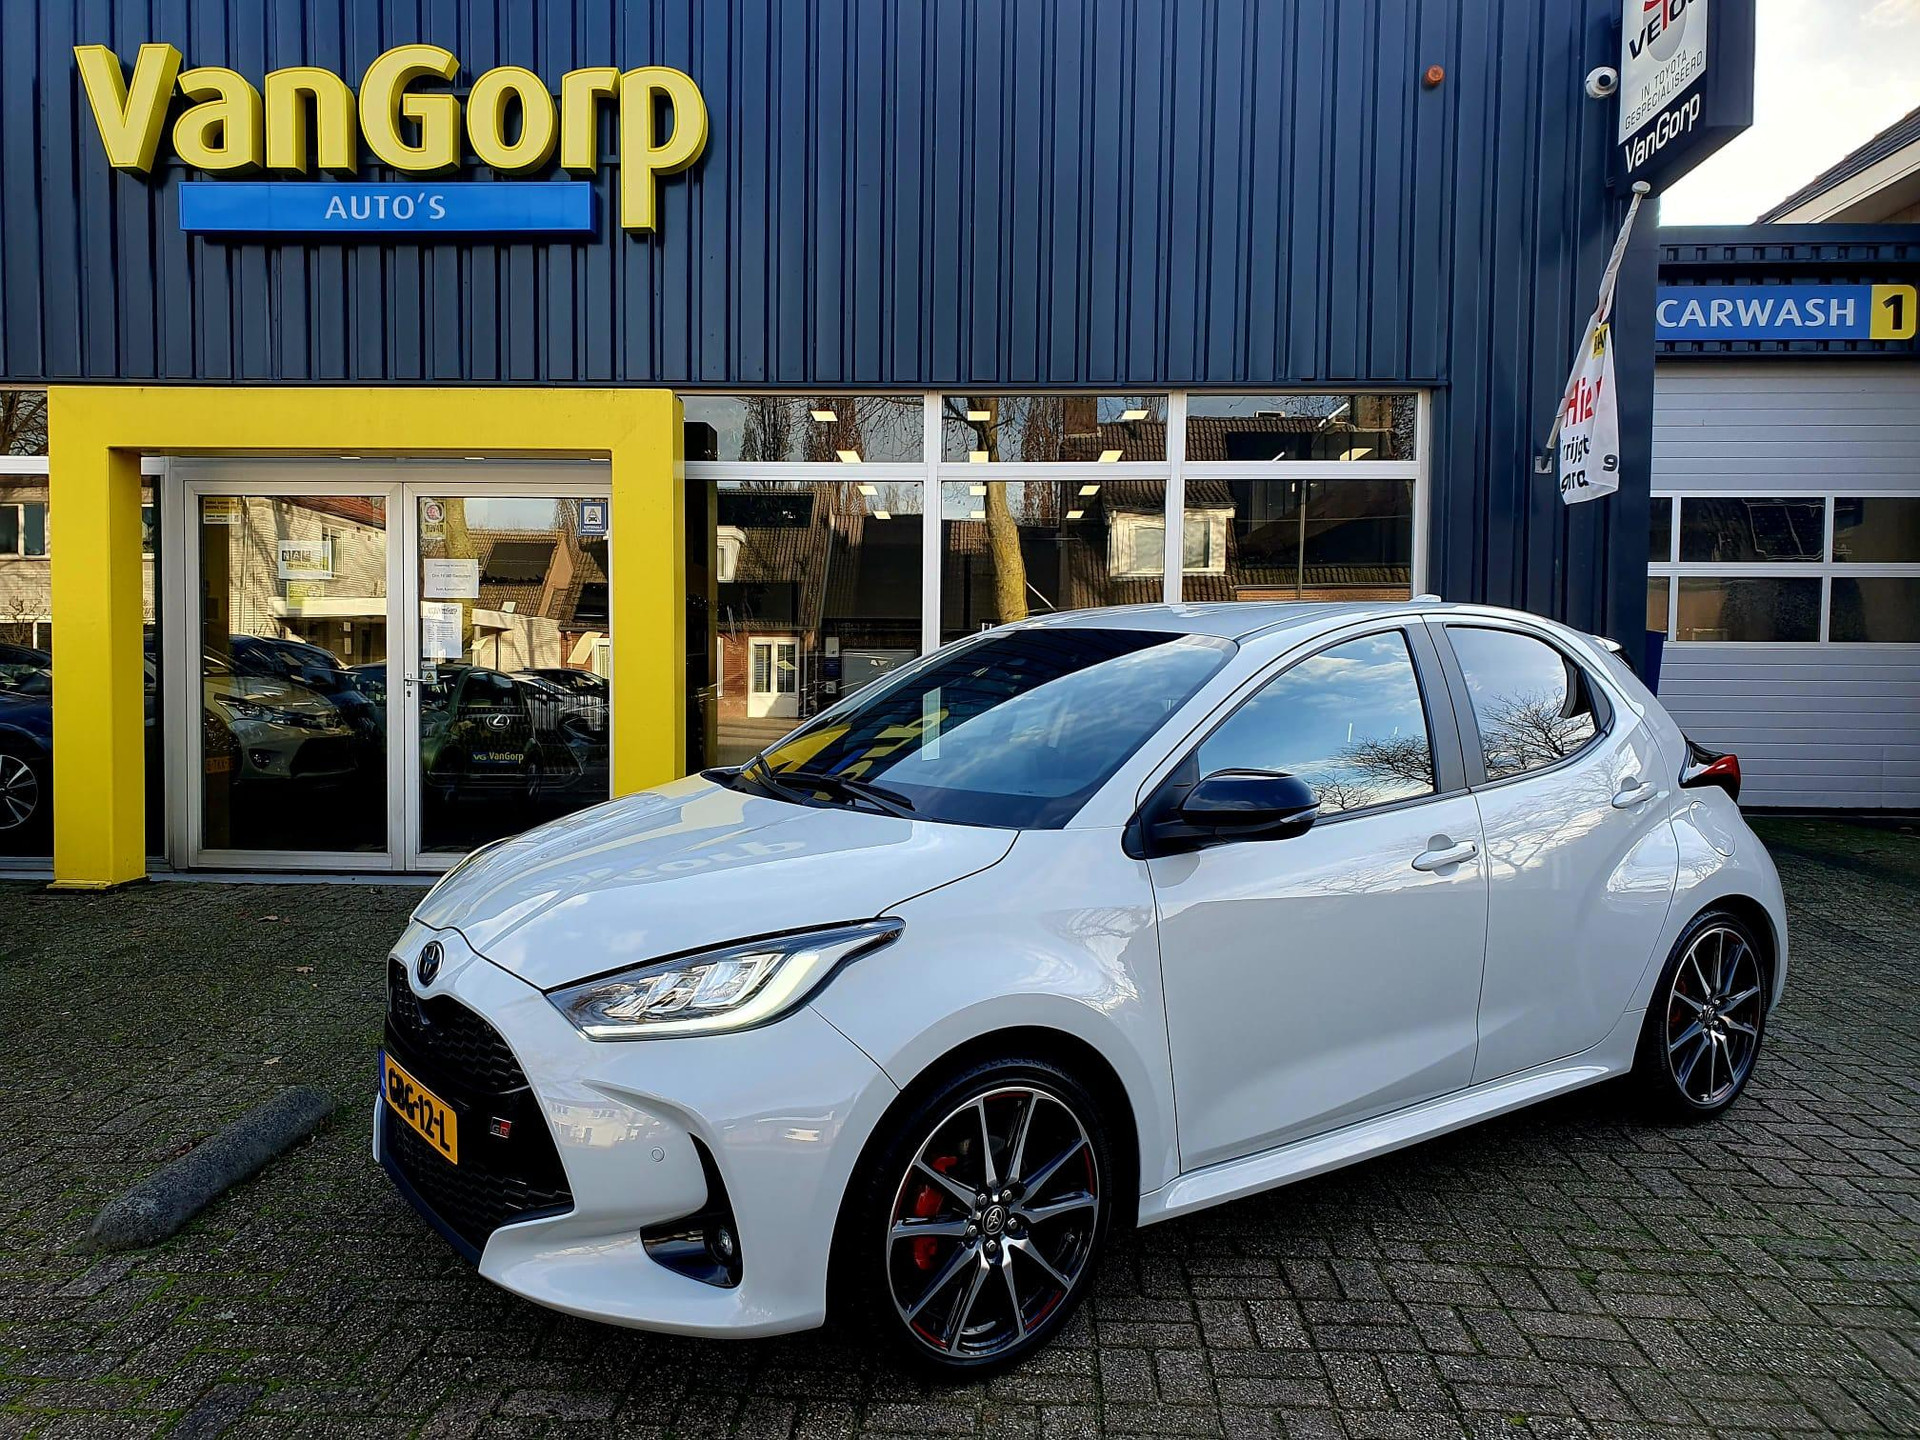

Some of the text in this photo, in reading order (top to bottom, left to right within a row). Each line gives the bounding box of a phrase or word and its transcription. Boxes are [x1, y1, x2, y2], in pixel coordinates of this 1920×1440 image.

[1625, 50, 1703, 130] GESPECIALISEERD
[1641, 49, 1687, 101] IN TOYOTA
[73, 43, 709, 234] VanGorp
[1625, 93, 1700, 173] VanGorp
[324, 192, 446, 220] AUTO'S
[1655, 294, 1904, 331] CARWASH 1
[1562, 434, 1589, 464] rijgt
[489, 751, 524, 764] VanGorp
